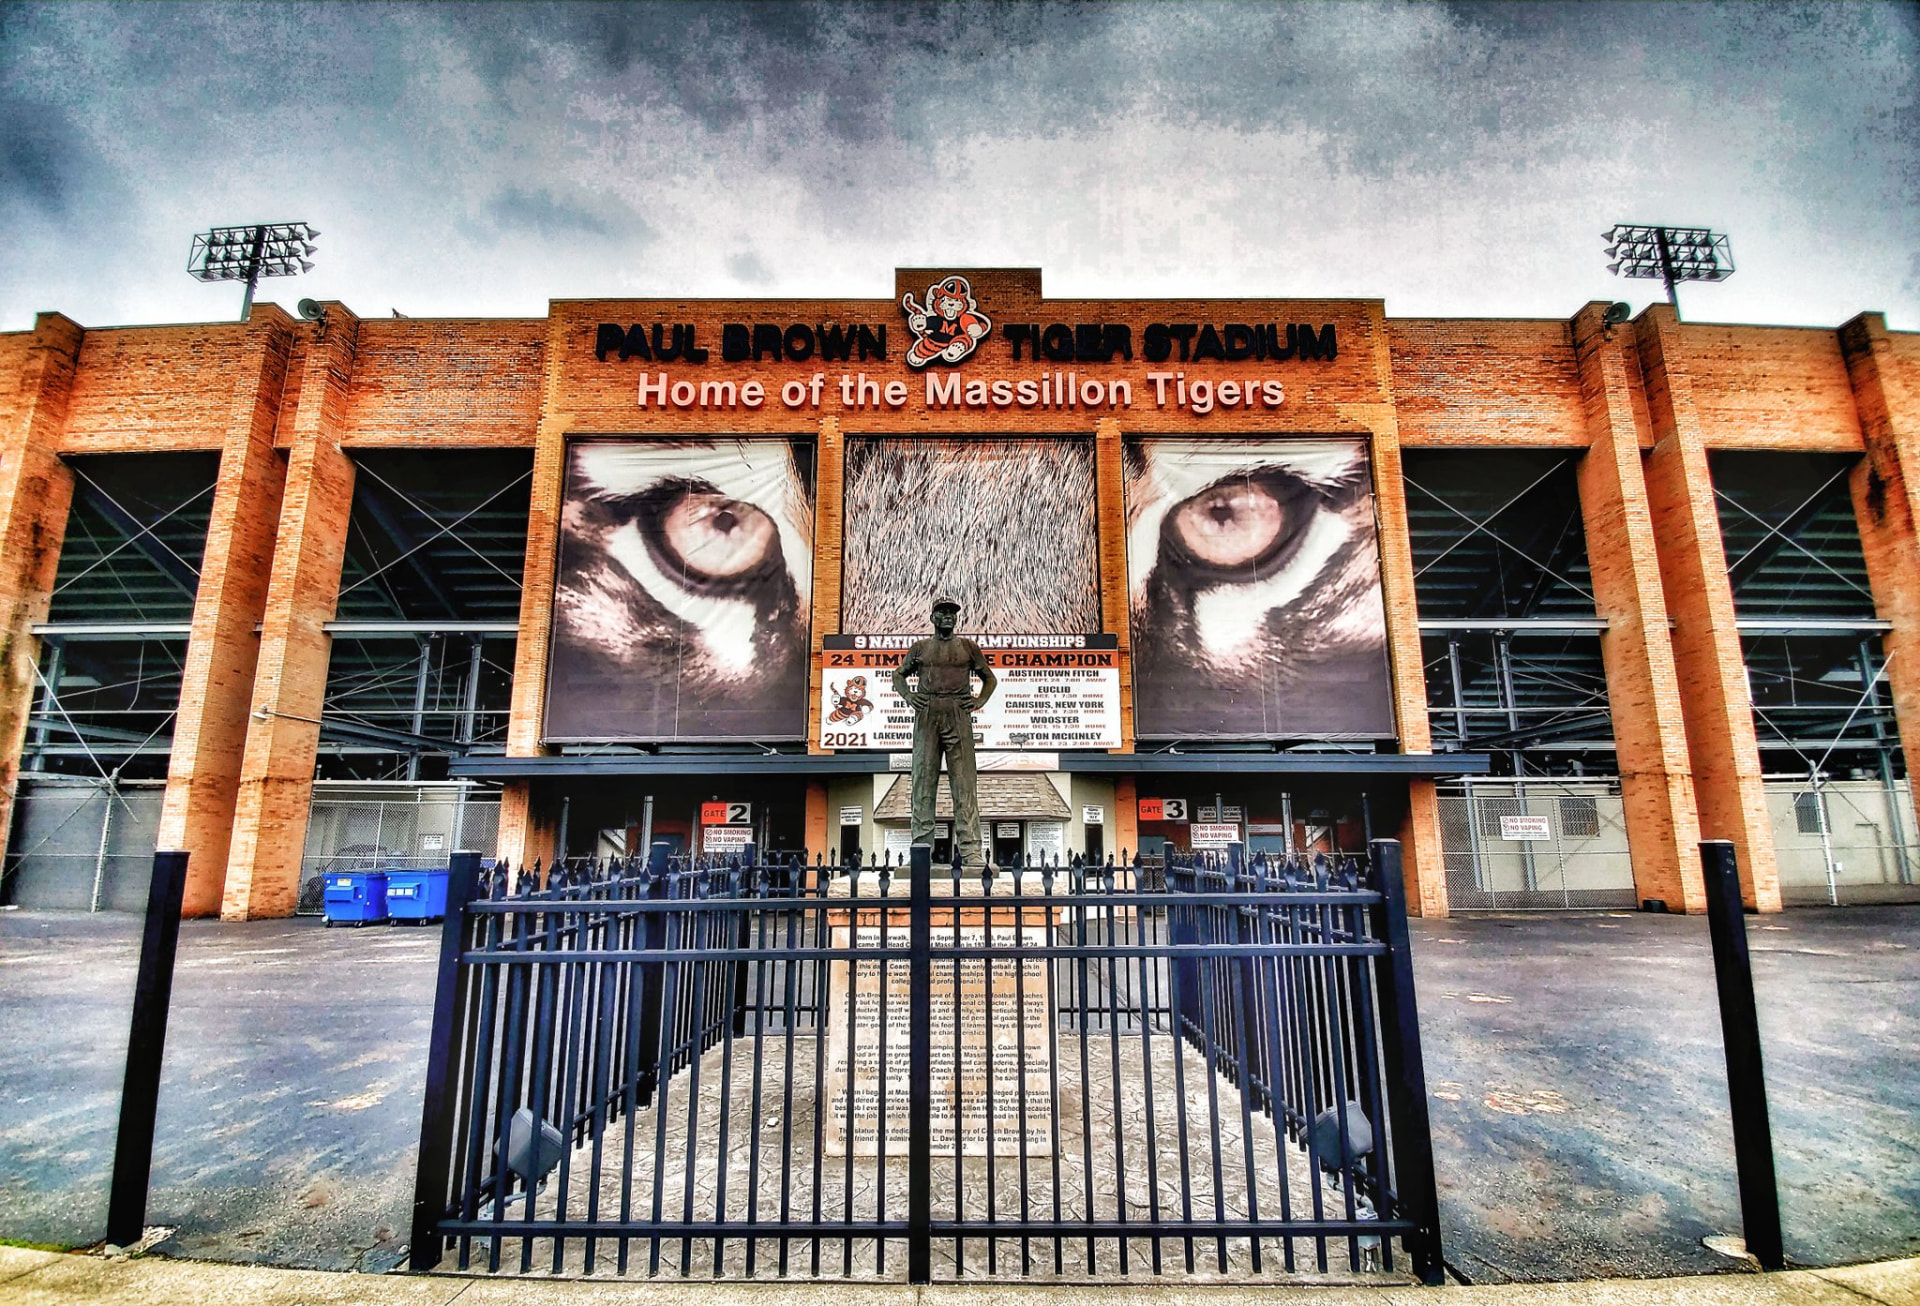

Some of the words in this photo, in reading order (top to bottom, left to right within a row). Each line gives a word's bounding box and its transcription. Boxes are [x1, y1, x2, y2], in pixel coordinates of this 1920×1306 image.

[939, 320, 957, 335] M
[596, 323, 708, 362] PAUL
[722, 323, 887, 362] BROWN
[1002, 323, 1134, 361] TIGER
[1143, 323, 1339, 361] STADIUM
[638, 372, 765, 407] Home
[781, 372, 825, 407] of
[838, 372, 908, 407] the
[925, 372, 1133, 408] Massillon
[1146, 372, 1285, 415] Tigers
[854, 635, 867, 649] 9
[830, 654, 855, 666] 24
[861, 654, 906, 666] TIM
[1001, 654, 1112, 666] CHAMPION
[1005, 701, 1053, 709] CANISIUS,
[824, 733, 867, 747] 2021
[1051, 732, 1102, 740] MCKINLEY
[729, 805, 747, 822] 2
[1166, 800, 1184, 818] 3
